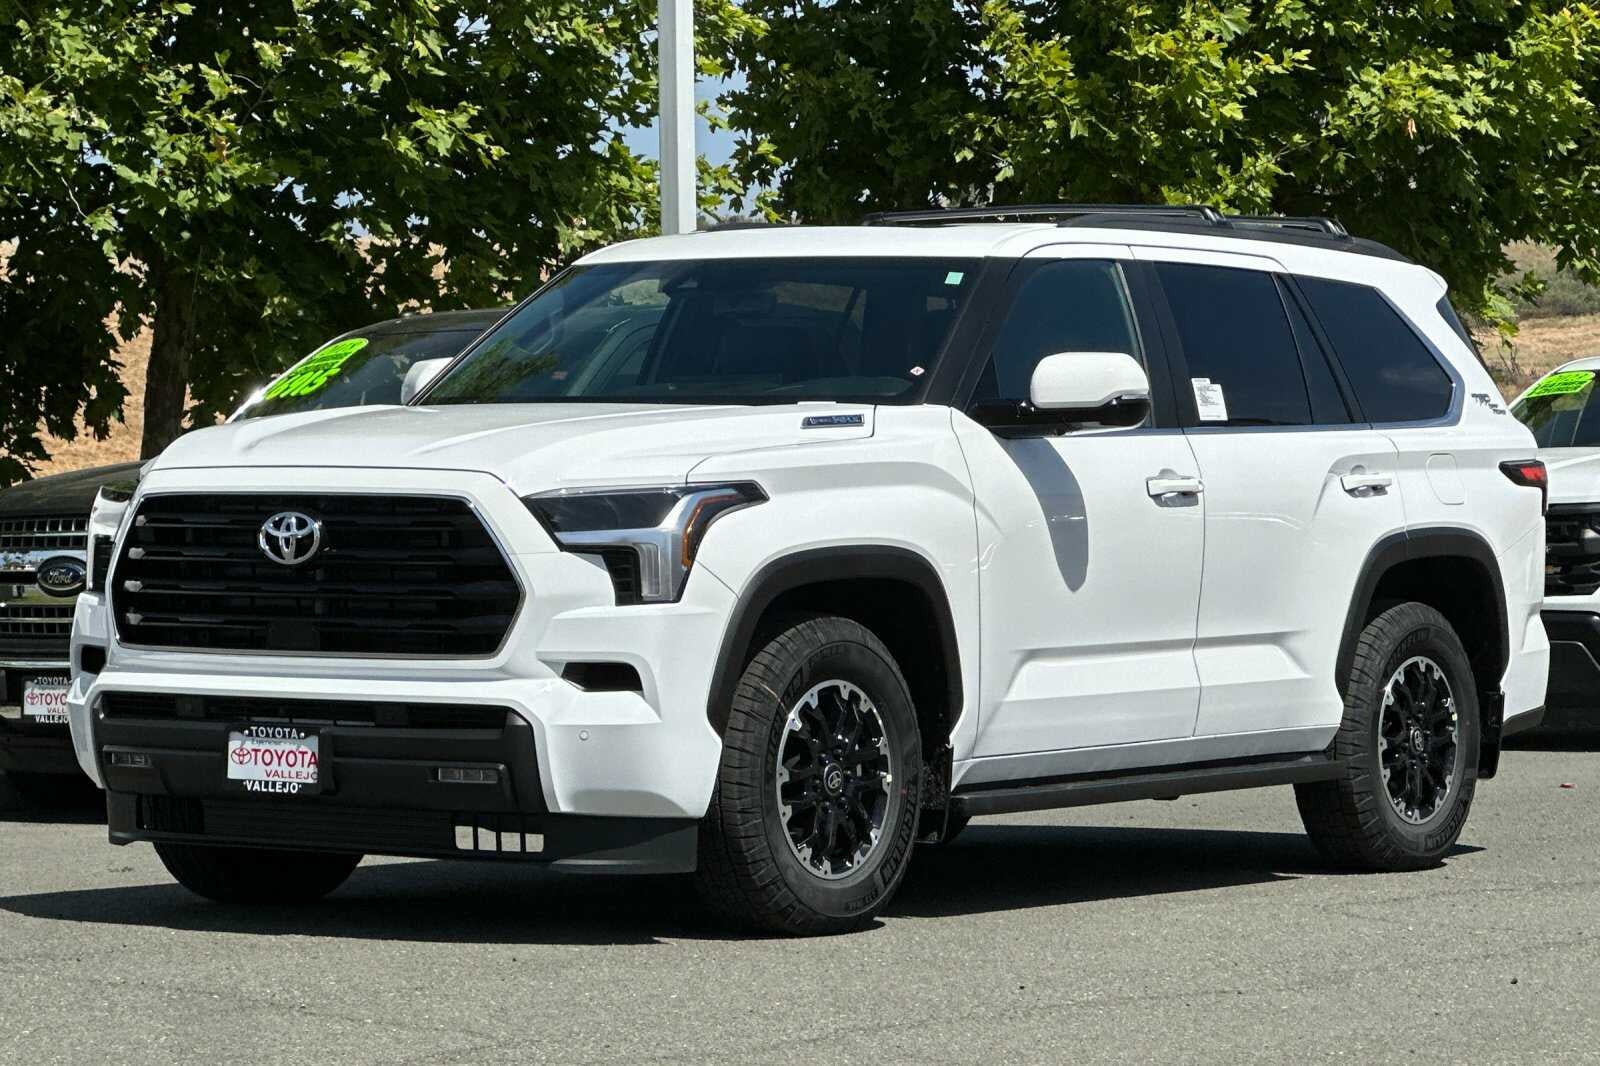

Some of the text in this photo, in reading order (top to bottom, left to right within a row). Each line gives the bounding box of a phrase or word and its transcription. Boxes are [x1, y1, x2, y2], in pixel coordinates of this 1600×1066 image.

[37, 676, 68, 686] TOYOTA
[39, 692, 68, 706] TOYO
[35, 714, 69, 724] VALLEJO
[250, 726, 298, 739] TOYOTA
[251, 748, 319, 768] TOYOTA
[265, 769, 318, 780] VALLEJO
[245, 779, 299, 793] VALLEJO
